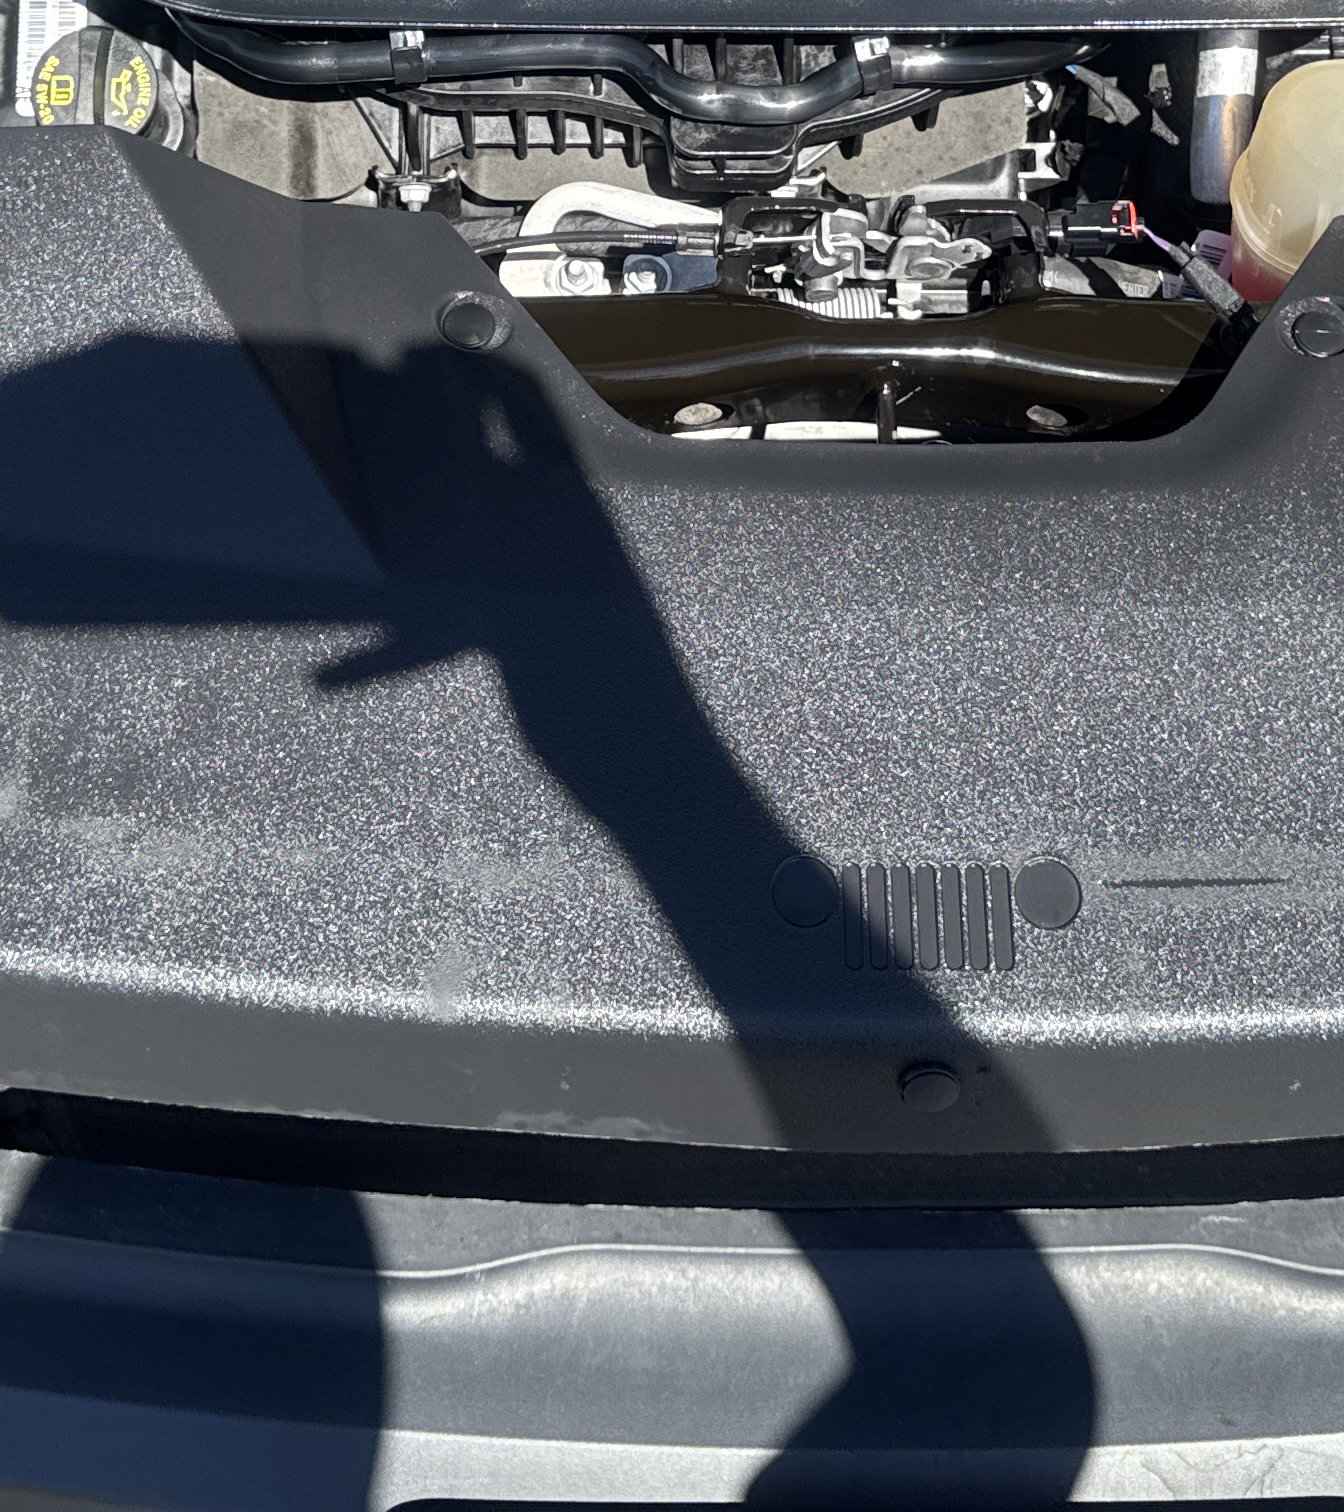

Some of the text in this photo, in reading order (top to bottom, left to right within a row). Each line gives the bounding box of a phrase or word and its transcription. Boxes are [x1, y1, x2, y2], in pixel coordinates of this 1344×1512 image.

[39, 56, 60, 81] SAE
[123, 56, 152, 129] ENGINE OIL
